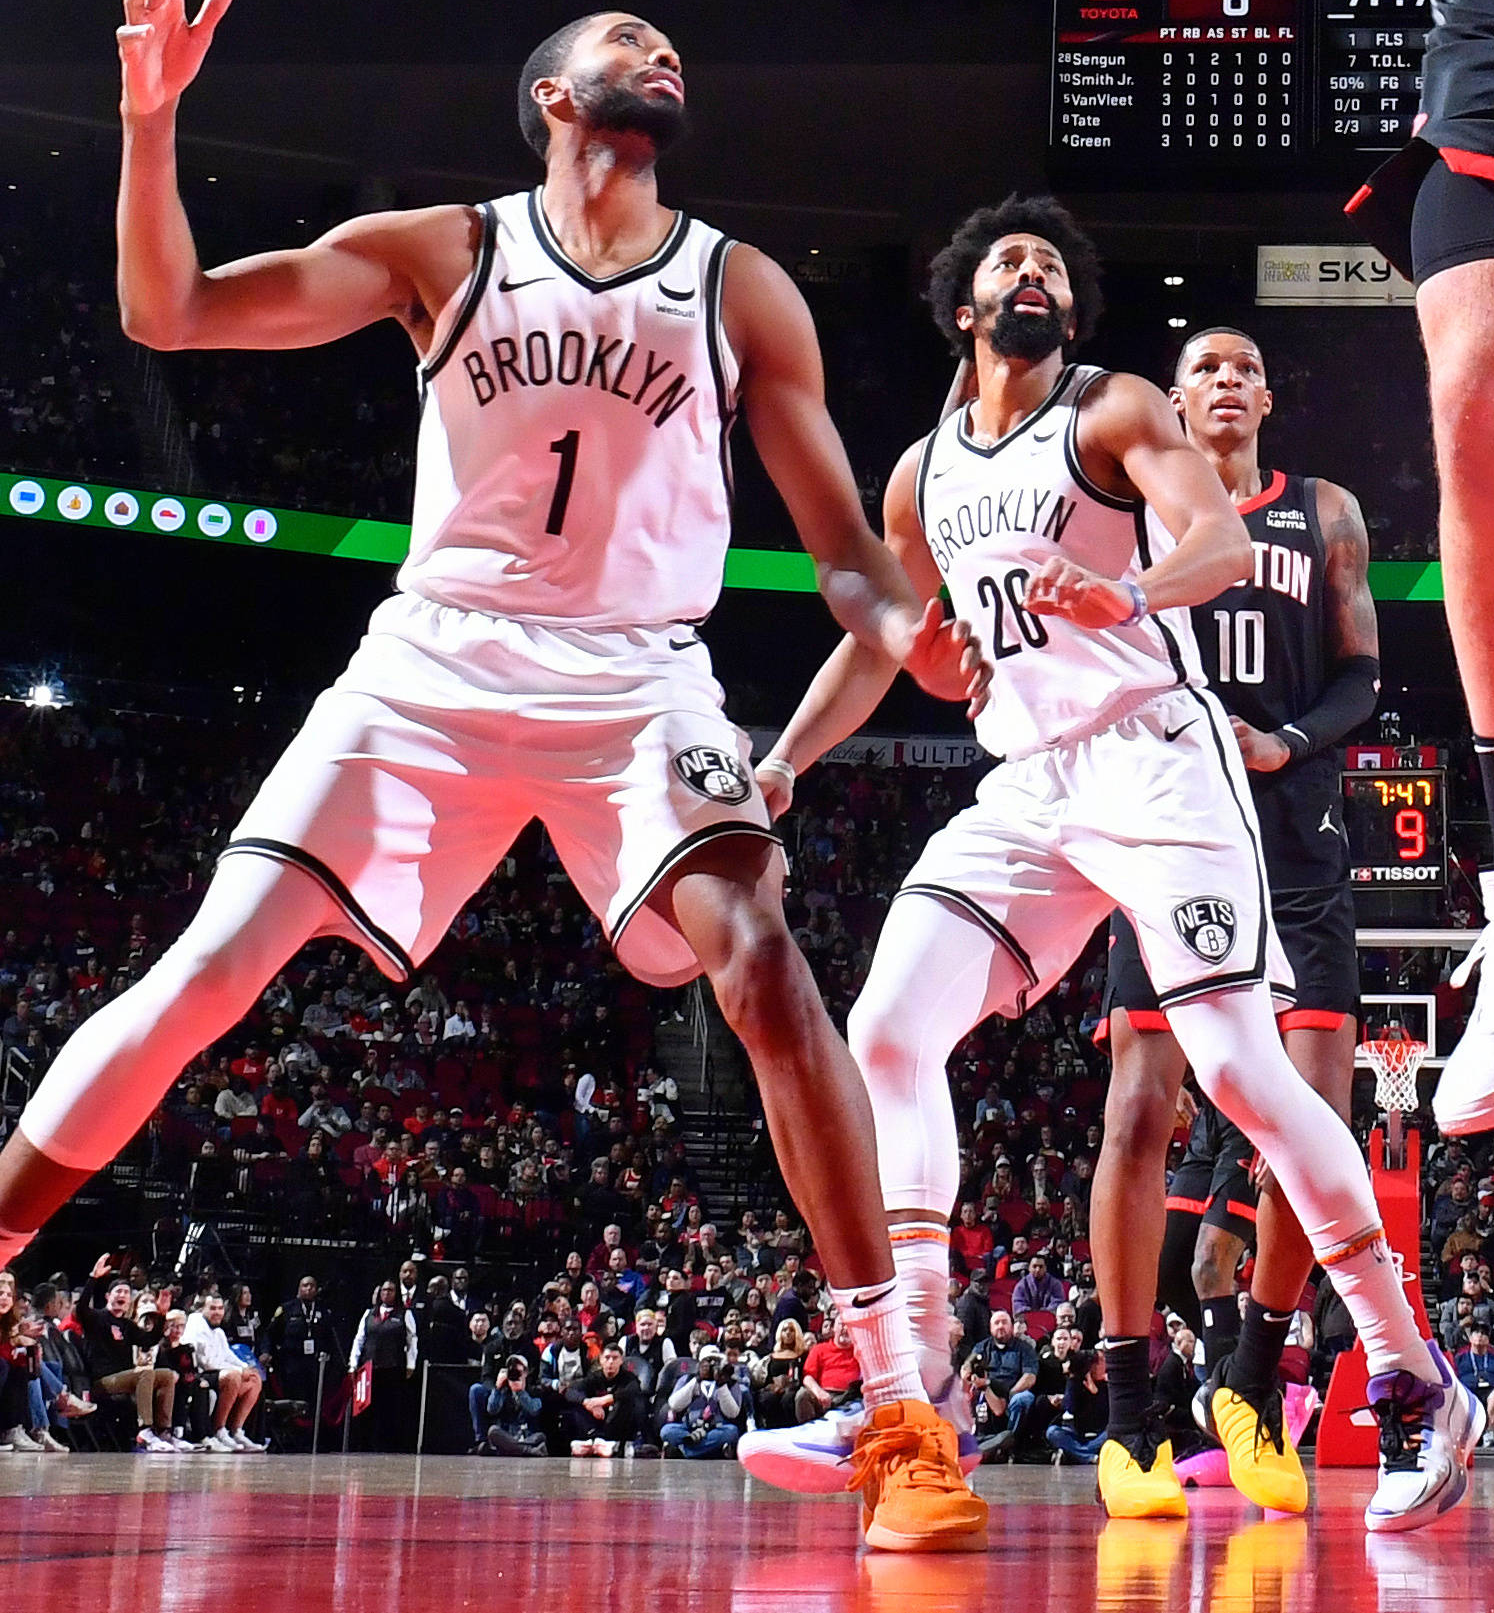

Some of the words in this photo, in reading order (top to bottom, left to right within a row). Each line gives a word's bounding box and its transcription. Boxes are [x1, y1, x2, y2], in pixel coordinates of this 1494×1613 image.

[1080, 8, 1138, 19] TOYOTA
[1159, 27, 1177, 39] PT
[1182, 27, 1201, 39] RB
[1206, 27, 1225, 39] AS
[1231, 27, 1248, 39] ST
[1254, 27, 1271, 39] BL
[1278, 27, 1294, 39] FL
[1349, 33, 1355, 45] 1
[1376, 33, 1403, 46] FLS
[1072, 52, 1126, 69] Sengun
[1163, 52, 1173, 66] 0
[1187, 52, 1195, 65] 1
[1210, 52, 1220, 66] 2
[1235, 52, 1242, 66] 1
[1258, 52, 1268, 66] 0
[1282, 52, 1291, 66] 0
[1348, 55, 1356, 67] 7
[1370, 55, 1410, 67] T.O.L.
[1071, 72, 1114, 86] Smith
[1116, 73, 1135, 86] Jr.
[1162, 72, 1172, 86] 2
[1186, 72, 1196, 86] 0
[1210, 72, 1220, 86] 0
[1234, 72, 1244, 86] 0
[1257, 72, 1267, 86] 0
[1281, 72, 1291, 86] 0
[1330, 77, 1364, 89] 50%
[1380, 77, 1399, 89] FG
[1070, 93, 1133, 107] VanVleet
[1162, 93, 1171, 106] 3
[1186, 93, 1196, 106] 0
[1210, 93, 1217, 106] 1
[1233, 92, 1243, 106] 0
[1257, 92, 1267, 106] 0
[1282, 92, 1289, 106] 1
[1335, 98, 1360, 112] 0/0
[1381, 98, 1398, 110] FT
[1070, 113, 1101, 127] Tate
[1161, 113, 1171, 127] 0
[1185, 113, 1195, 127] 0
[1209, 113, 1219, 127] 0
[1233, 113, 1243, 127] 0
[1257, 113, 1267, 126] 0
[1281, 113, 1291, 127] 0
[1335, 120, 1359, 134] 2/3
[1380, 120, 1399, 132] 3P
[1070, 134, 1111, 148] Green
[1161, 133, 1170, 147] 3
[1186, 134, 1193, 147] 1
[1209, 133, 1219, 148] 0
[1233, 133, 1243, 147] 0
[1257, 133, 1267, 147] 0
[1281, 133, 1291, 147] 0
[1318, 261, 1392, 282] SKY
[655, 302, 696, 319] Webull
[463, 330, 696, 429] BROOKLYN
[545, 429, 581, 536] 1
[1267, 509, 1306, 522] credit
[929, 489, 1078, 574] BROOKLYN
[1266, 517, 1307, 531] karma
[1213, 609, 1265, 684] 10
[911, 745, 977, 764] ULTR
[679, 748, 748, 782] NETS
[1373, 780, 1431, 806] 7:47
[1396, 810, 1424, 858] 9
[1372, 866, 1440, 881] TISSOT
[1176, 900, 1235, 935] NETS
